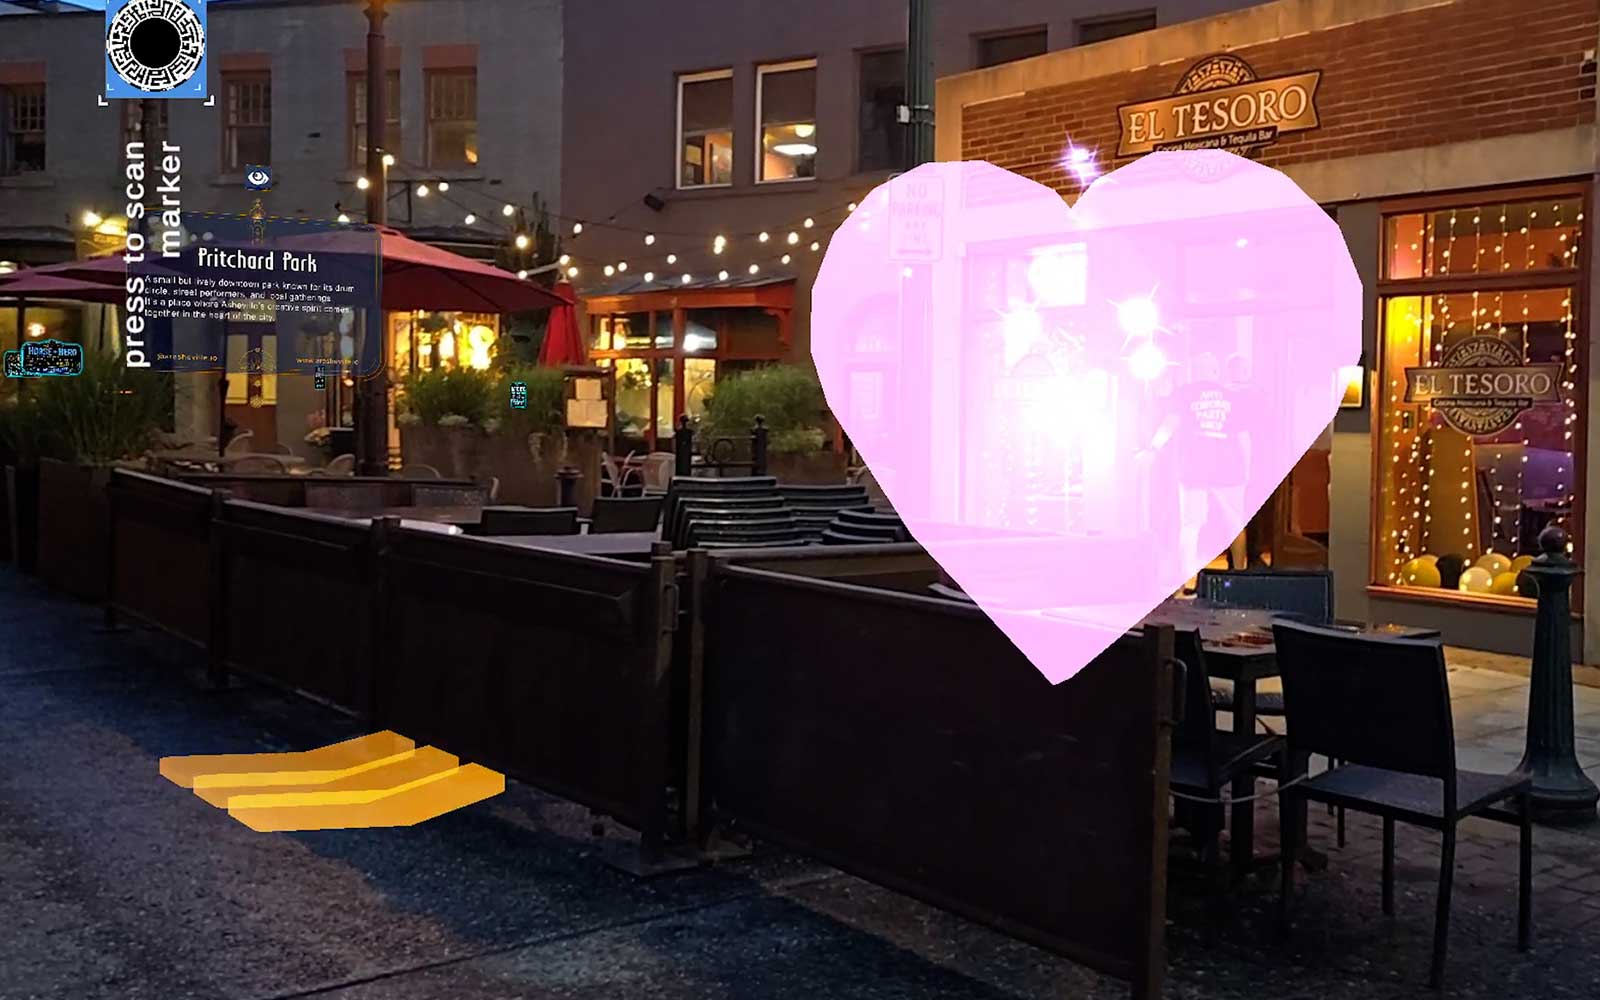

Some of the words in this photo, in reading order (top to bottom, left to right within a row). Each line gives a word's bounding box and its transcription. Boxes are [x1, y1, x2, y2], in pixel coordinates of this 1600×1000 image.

[1129, 110, 1168, 144] EL
[1172, 86, 1307, 136] TESORO
[1229, 132, 1257, 145] Tequila
[1258, 129, 1273, 140] Bar
[1415, 374, 1442, 395] EL
[1449, 373, 1550, 395] TESORO
